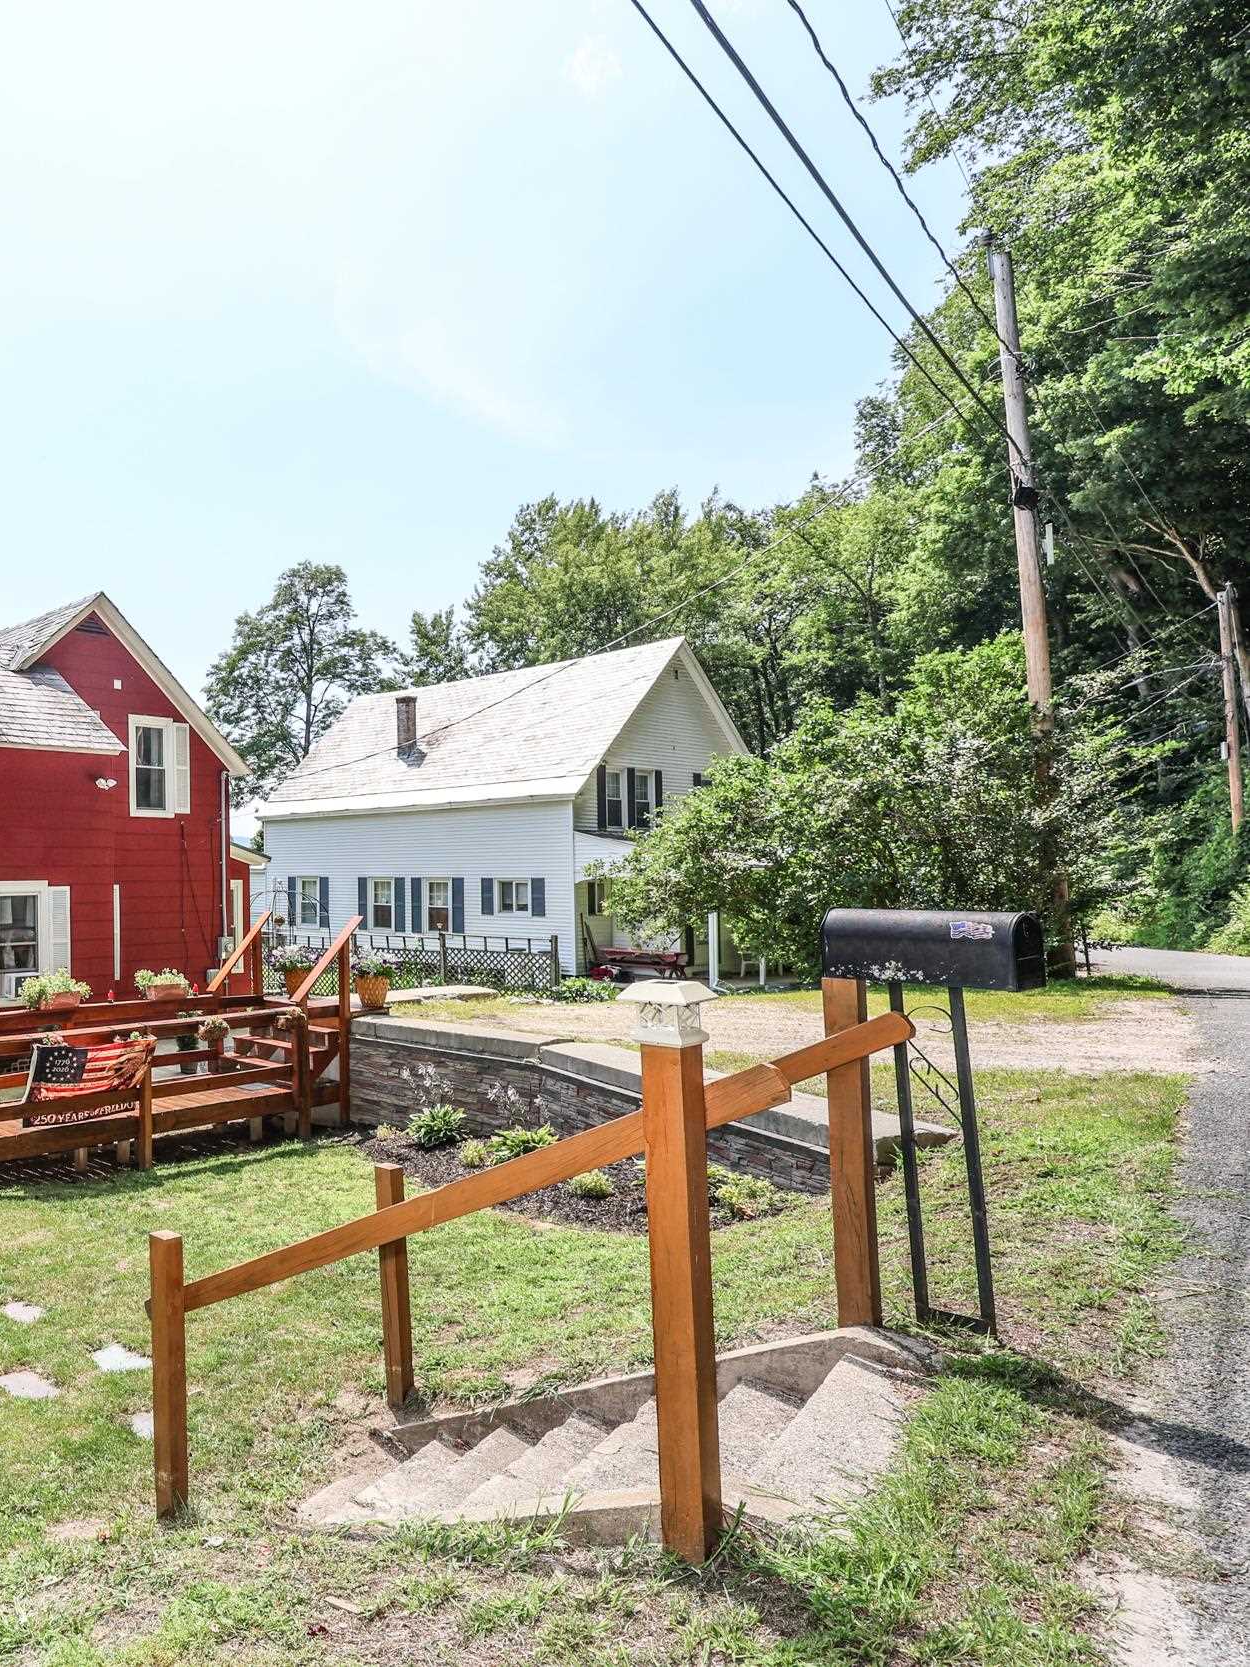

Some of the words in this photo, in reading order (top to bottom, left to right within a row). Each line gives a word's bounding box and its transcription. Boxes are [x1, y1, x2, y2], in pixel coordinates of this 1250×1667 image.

[55, 1058, 70, 1066] 1776
[34, 1114, 56, 1125] 250
[57, 1110, 89, 1123] YEARS
